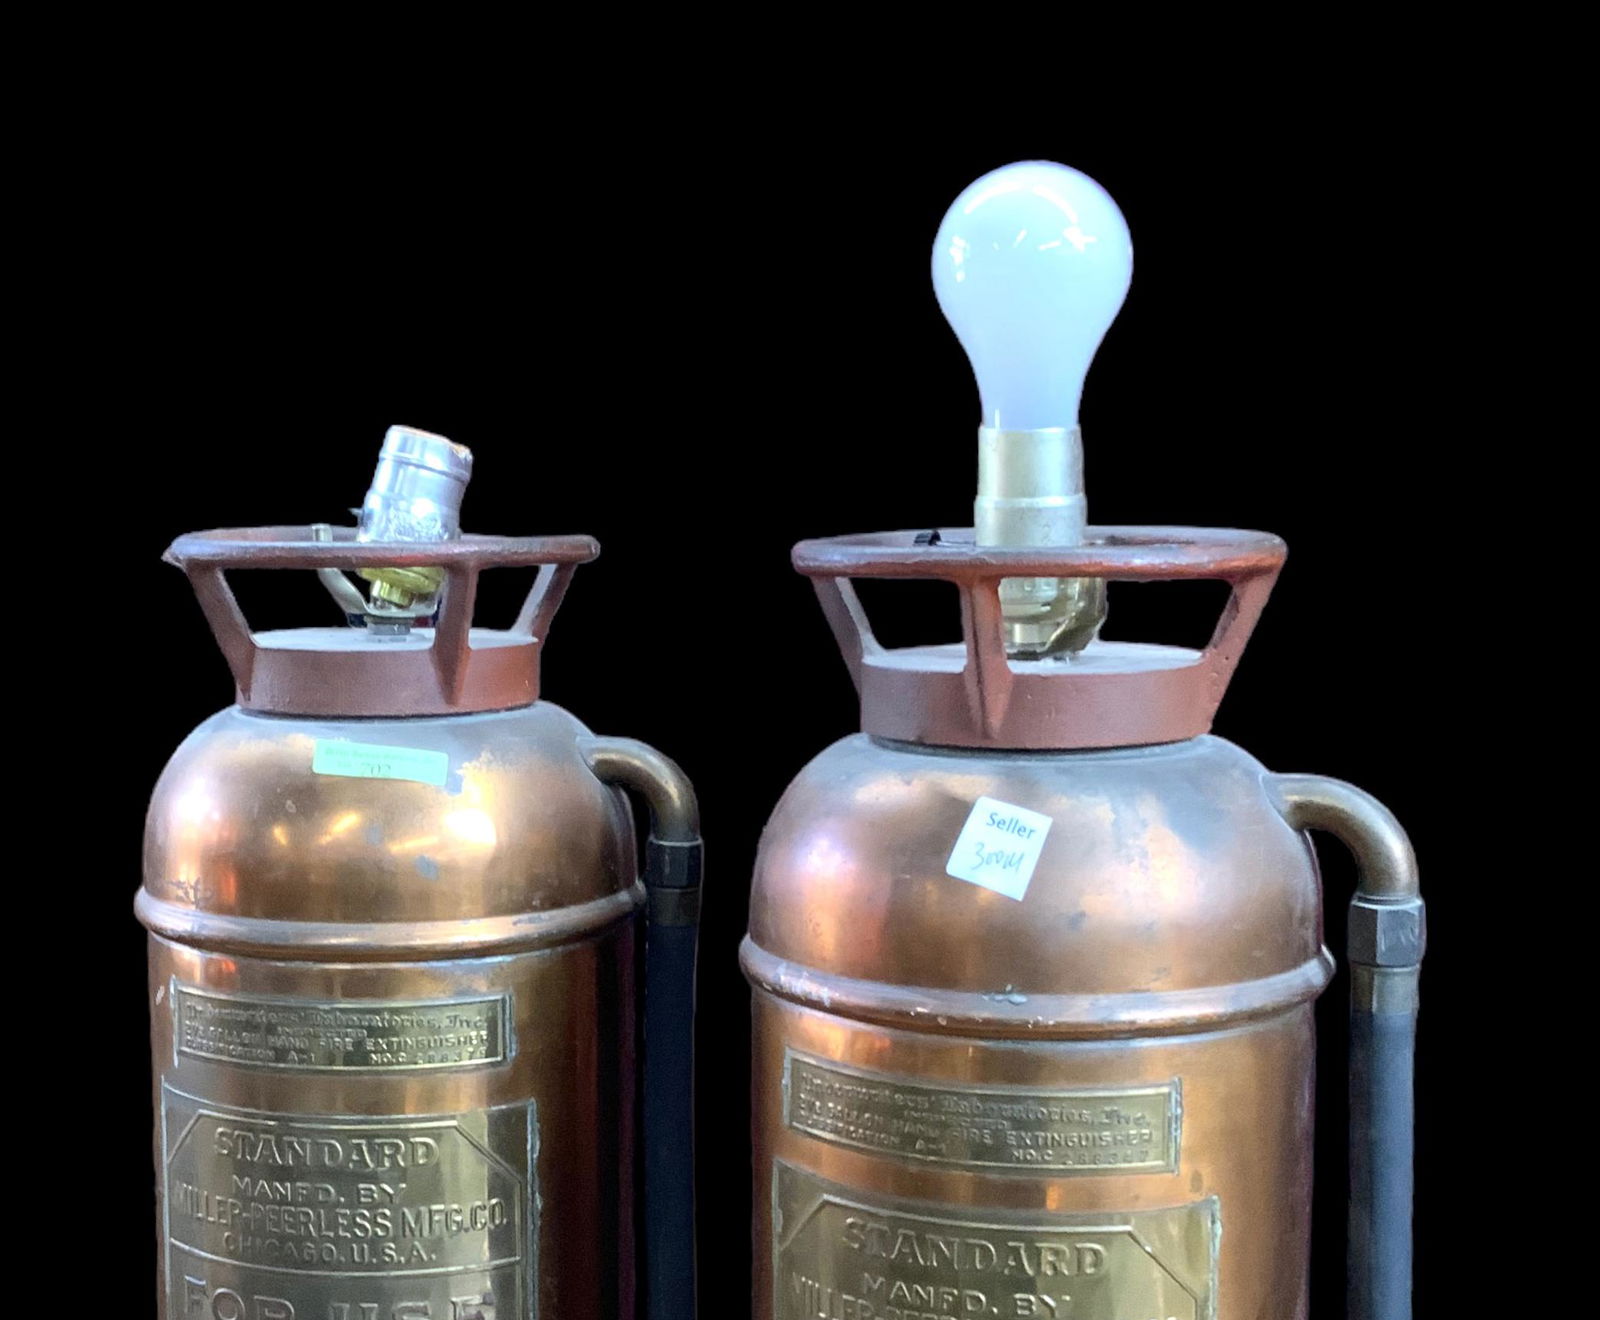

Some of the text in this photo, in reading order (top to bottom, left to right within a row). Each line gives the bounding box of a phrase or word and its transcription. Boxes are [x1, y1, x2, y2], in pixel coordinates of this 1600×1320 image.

[986, 812, 1036, 839] Seller
[267, 1035, 309, 1050] HAND
[319, 1037, 354, 1052] FIRE
[214, 1127, 440, 1170] STANDARD
[951, 1127, 993, 1145] FIRE
[1006, 1128, 1153, 1148] EXTINGUISHER
[232, 1174, 407, 1204] MANFD. BY
[352, 1240, 437, 1265] U.S.A.
[842, 1216, 1108, 1277] STANDARD
[862, 1271, 1071, 1319] MANFD. BY
